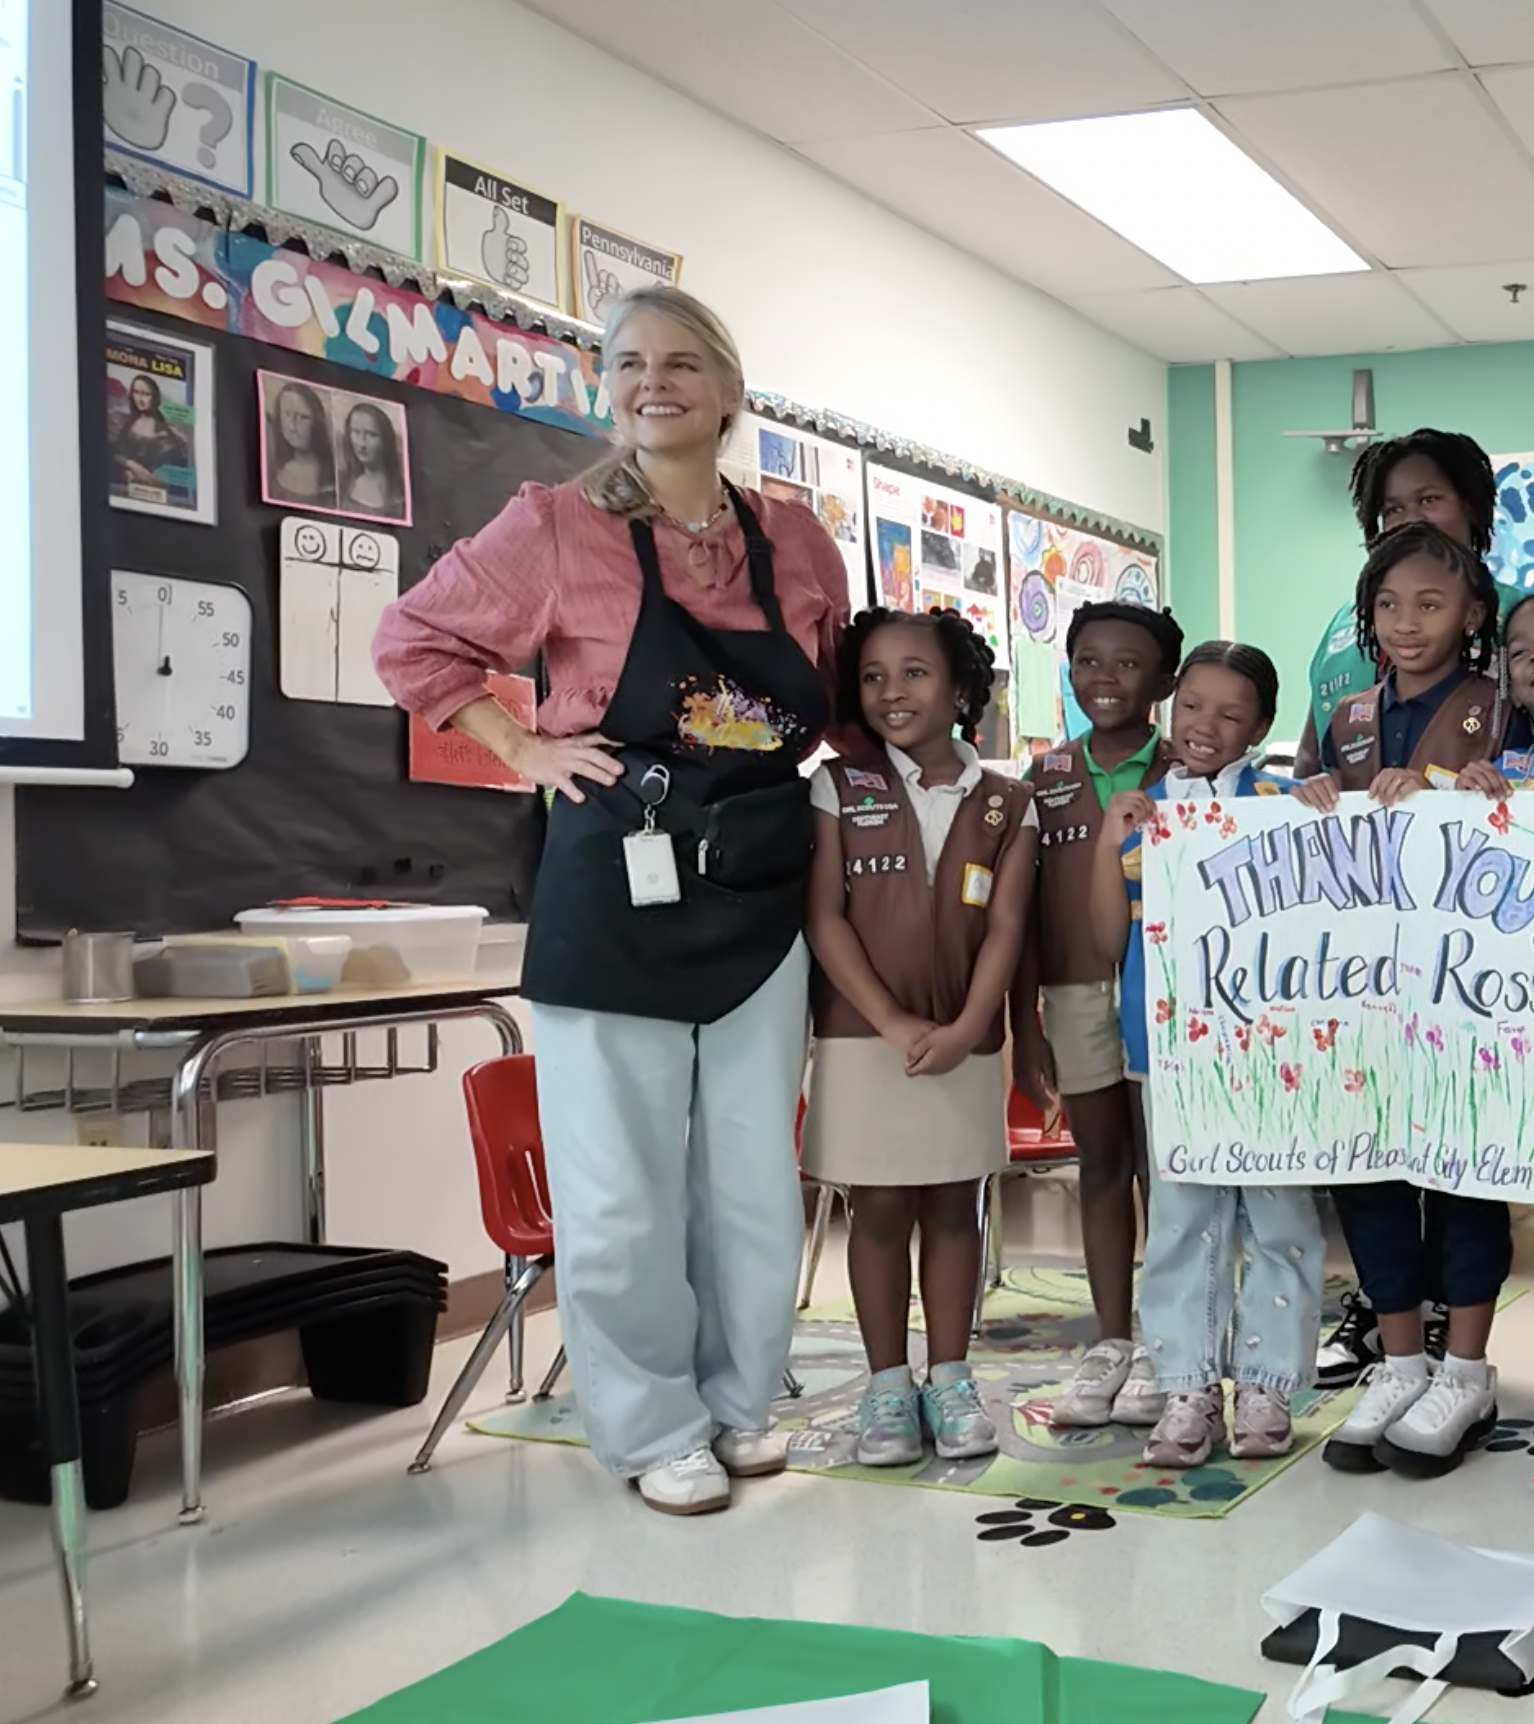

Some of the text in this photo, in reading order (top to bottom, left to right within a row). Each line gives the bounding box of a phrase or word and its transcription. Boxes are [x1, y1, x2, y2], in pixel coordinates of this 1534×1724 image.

[104, 11, 220, 81] Question
[316, 108, 378, 149] Agree
[473, 176, 530, 215] All Set
[582, 225, 675, 278] Pennsylvania
[106, 347, 184, 378] MONA LISA
[117, 589, 128, 606] 5
[197, 600, 215, 618] 55
[221, 631, 240, 648] 50
[226, 669, 245, 686] 45
[215, 704, 236, 720] 40
[149, 740, 169, 757] 30
[193, 730, 212, 747] 35
[1041, 824, 1088, 846] 4122
[1197, 806, 1416, 928] THANK
[1194, 922, 1403, 1025] Related
[1168, 1142, 1221, 1176] Girl
[1226, 1135, 1307, 1174] Scouts
[1315, 1138, 1346, 1176] of
[1347, 1131, 1430, 1176] Pleasant
[1433, 1144, 1469, 1191] City
